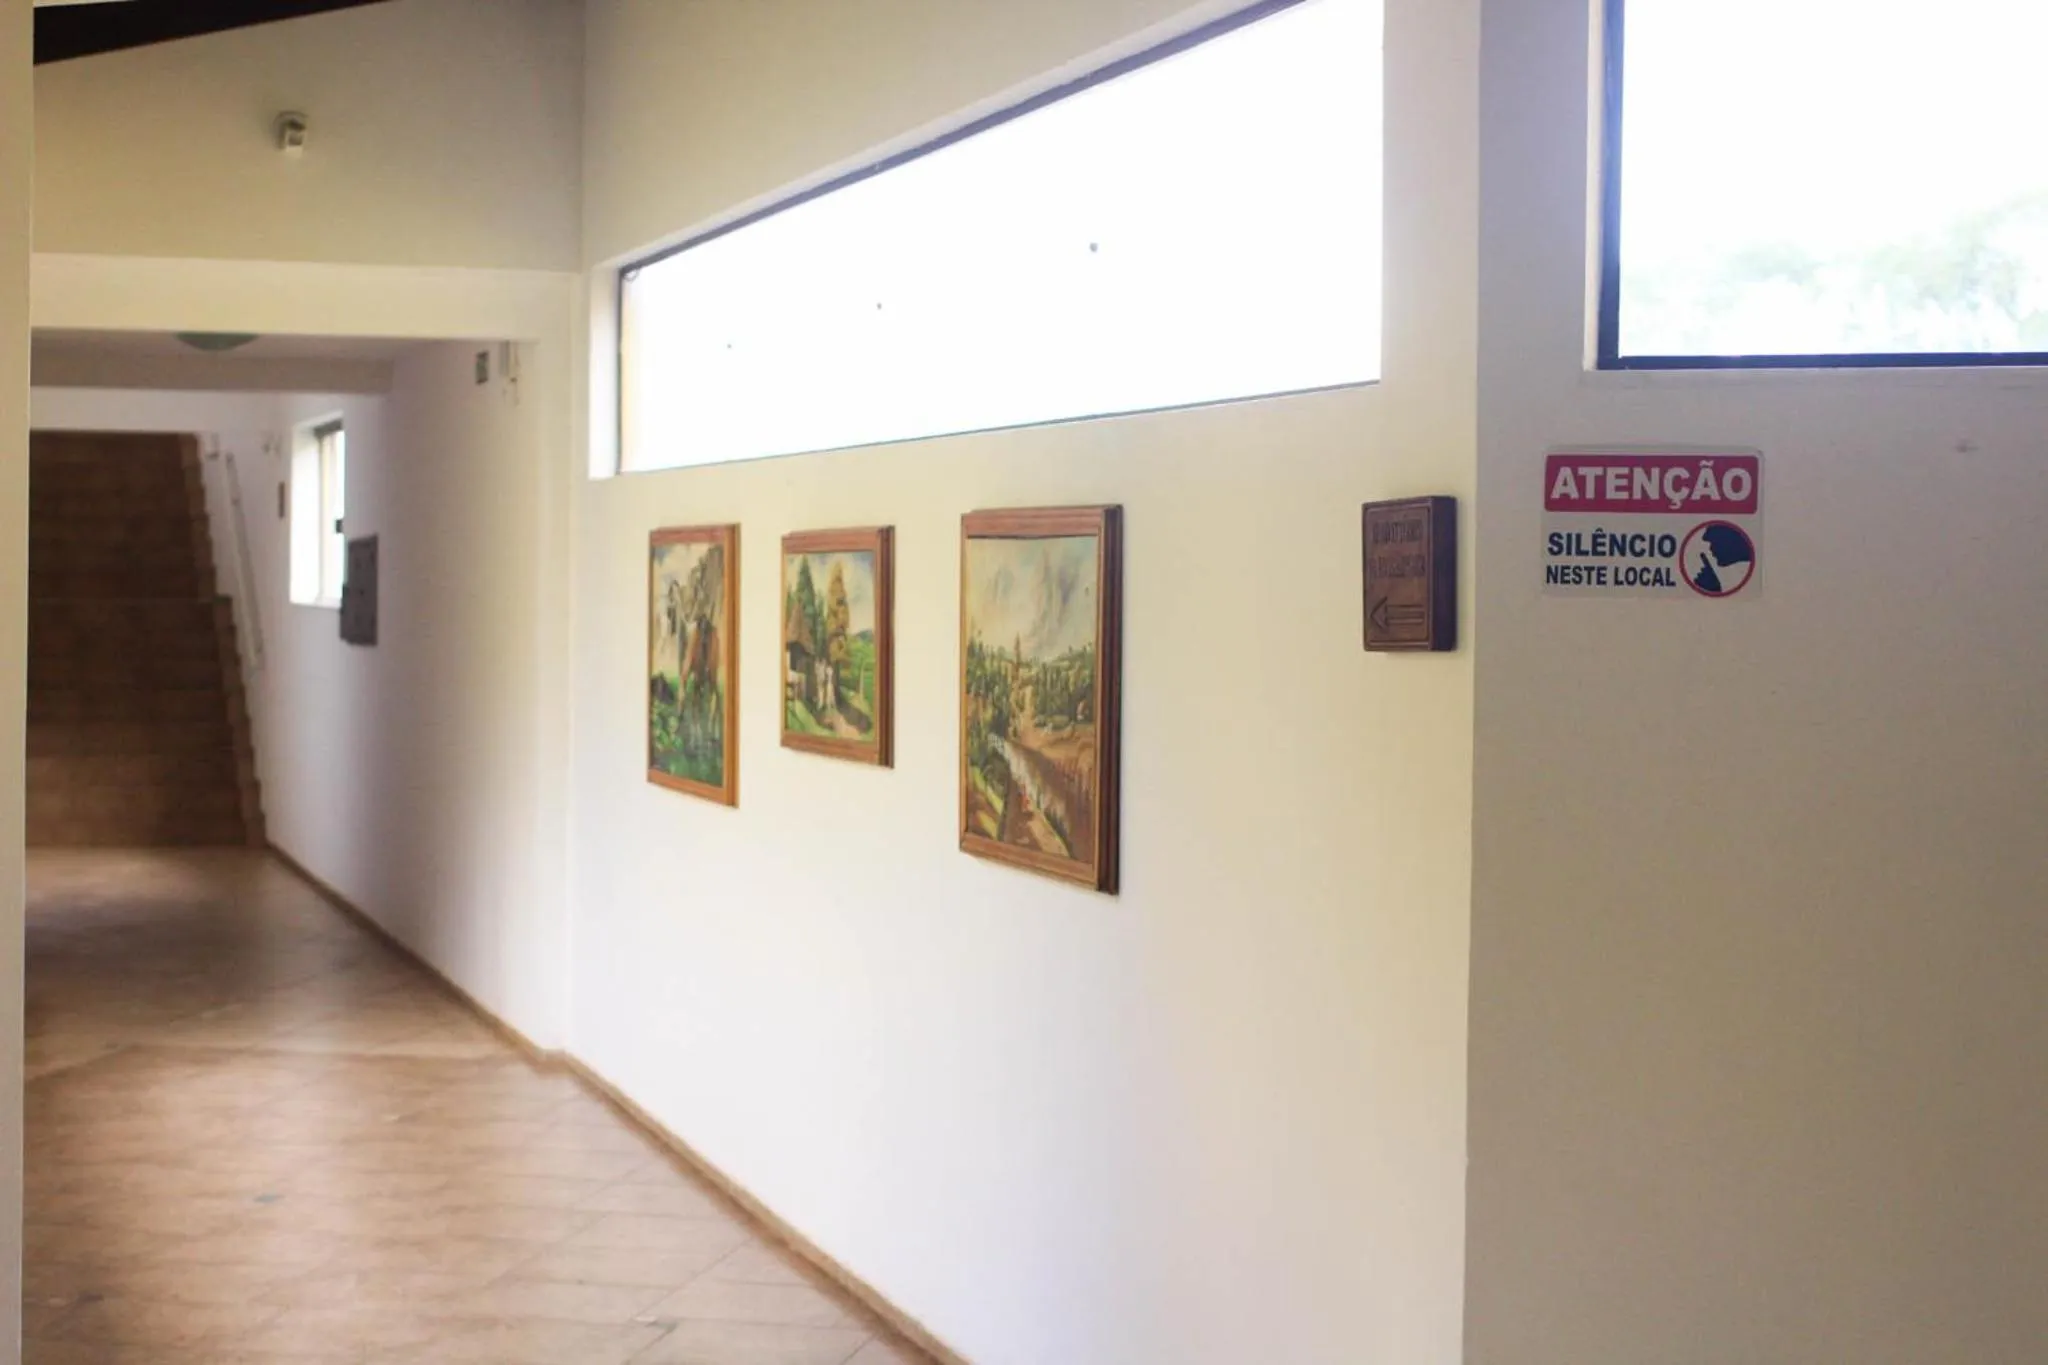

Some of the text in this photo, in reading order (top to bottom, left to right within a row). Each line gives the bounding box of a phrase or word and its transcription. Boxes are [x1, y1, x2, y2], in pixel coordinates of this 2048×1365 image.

[1551, 460, 1752, 510] ATENÇÃO
[1547, 528, 1677, 558] SILÊNCIO
[1546, 565, 1676, 587] NESTE LOCAL
